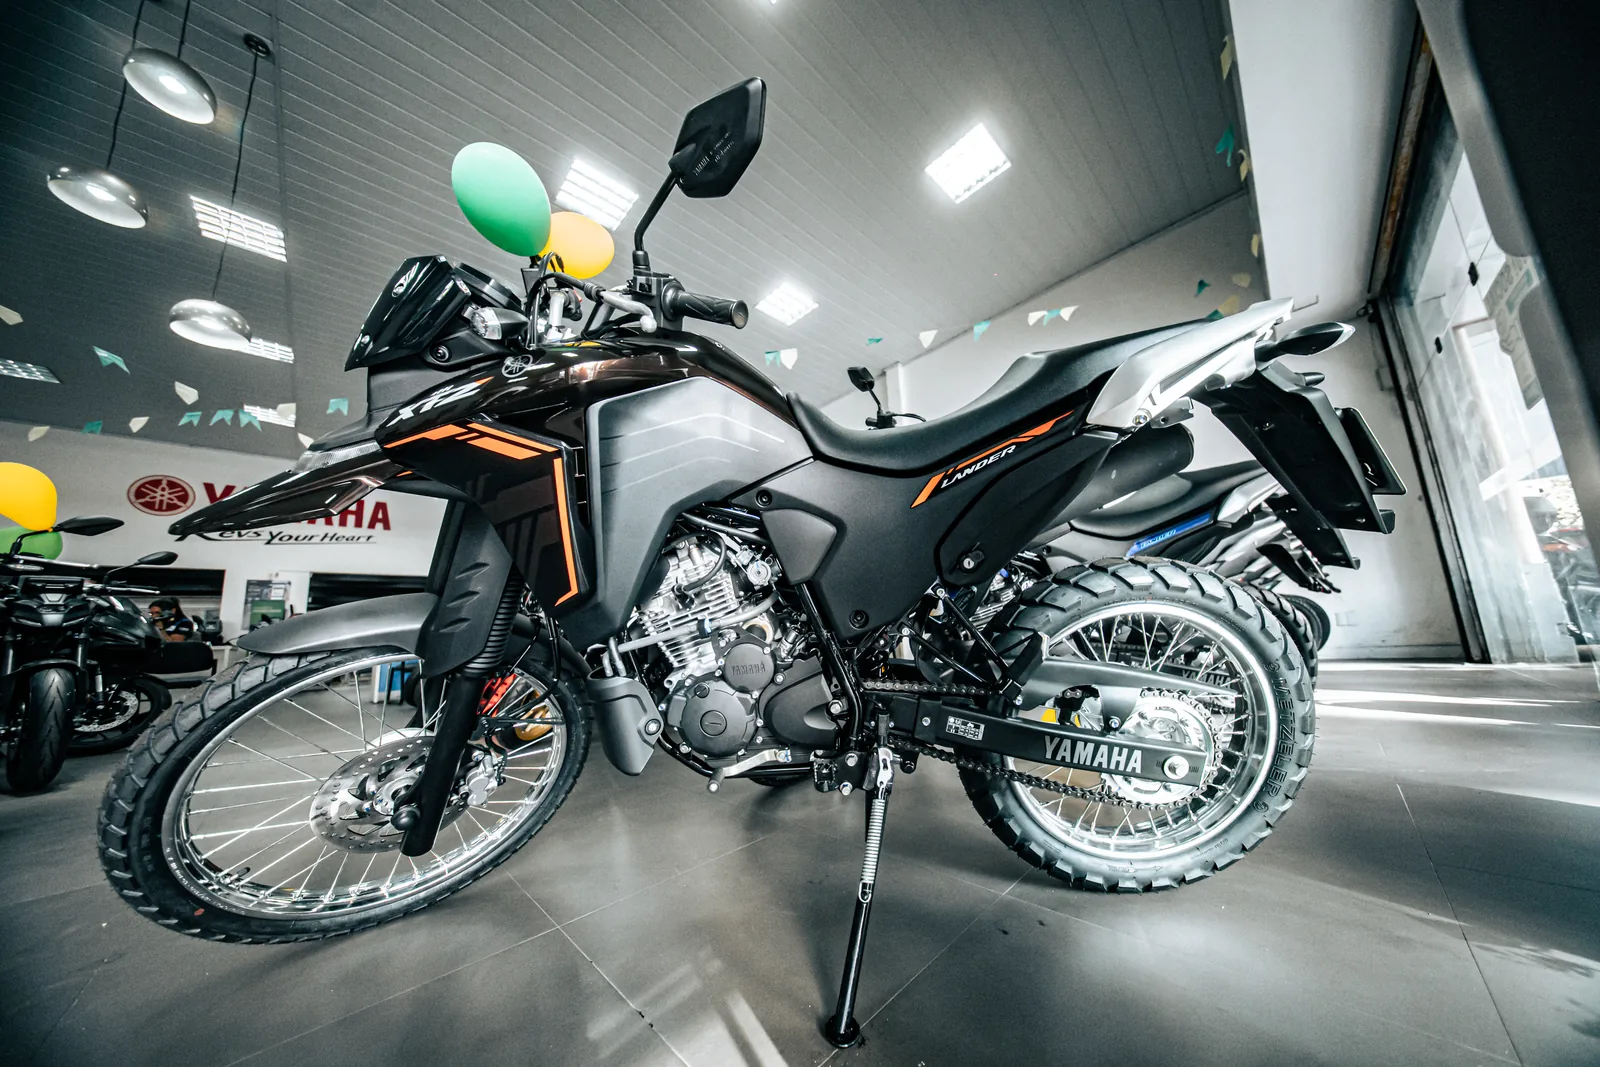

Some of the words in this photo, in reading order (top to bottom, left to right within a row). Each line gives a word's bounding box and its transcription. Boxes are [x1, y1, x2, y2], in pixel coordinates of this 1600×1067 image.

[941, 445, 1016, 488] LANDER
[175, 530, 263, 542] evs
[264, 531, 320, 545] Your
[320, 532, 376, 542] Heart
[731, 661, 766, 675] YAMAHA
[1045, 736, 1142, 773] YAMAHA
[1263, 676, 1296, 798] METZELER
